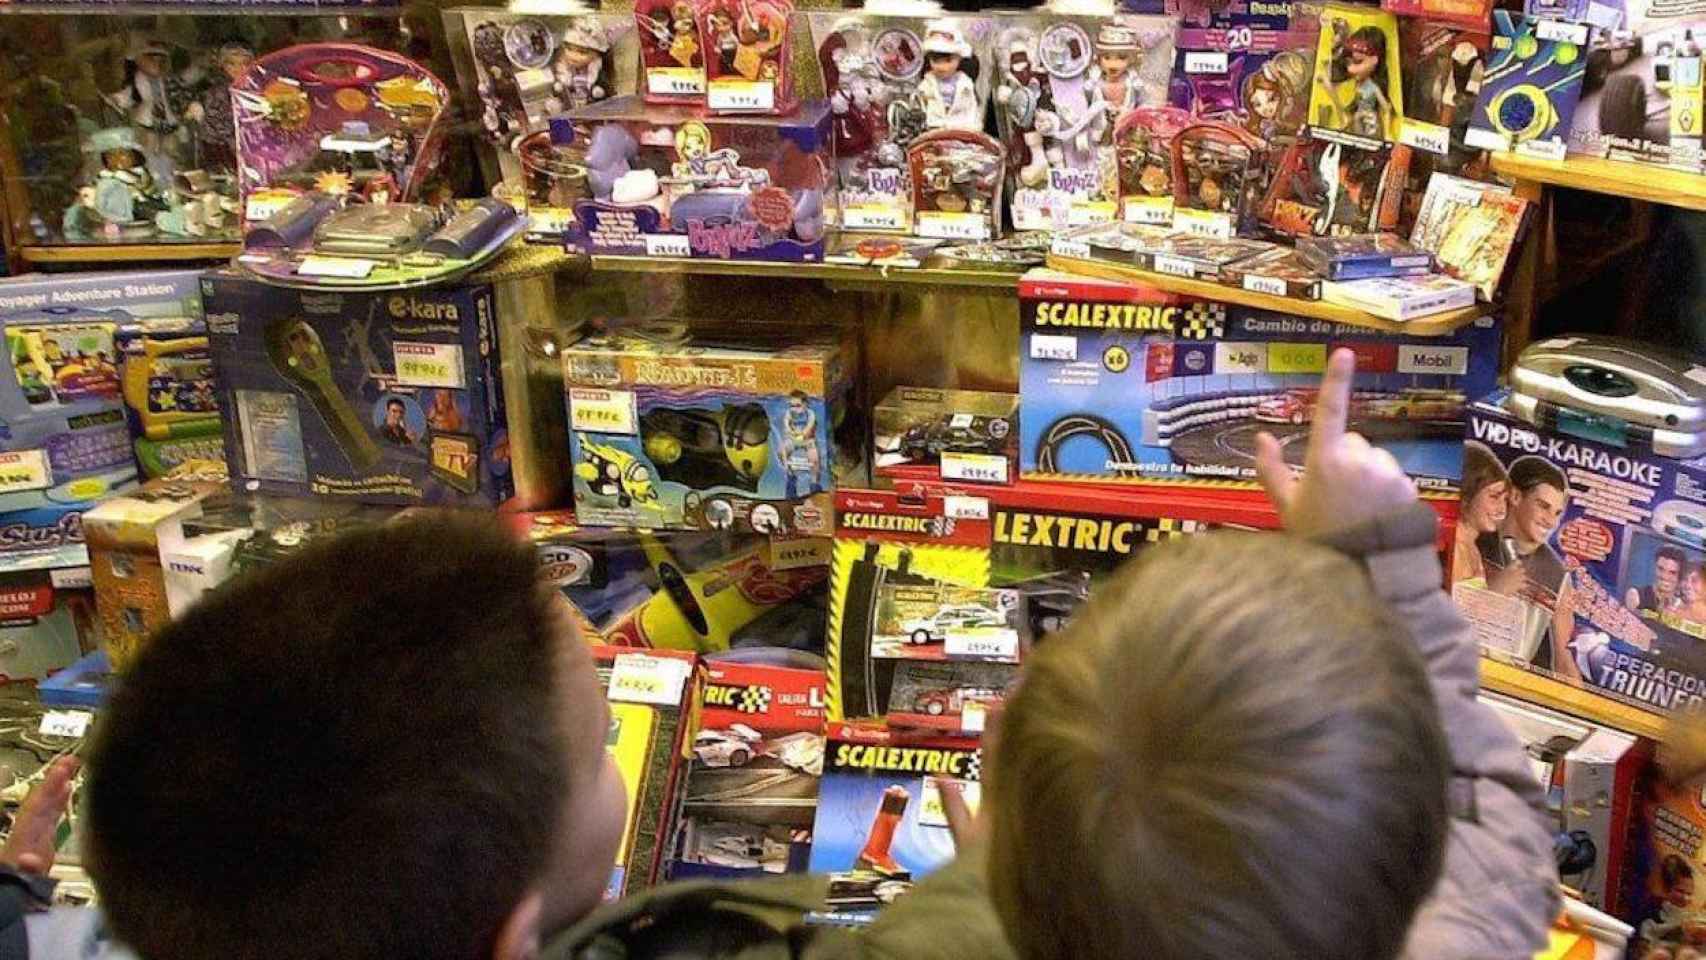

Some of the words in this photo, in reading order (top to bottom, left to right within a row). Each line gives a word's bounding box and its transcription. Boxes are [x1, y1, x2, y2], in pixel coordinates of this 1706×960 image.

[1227, 28, 1251, 48] 20
[52, 285, 122, 303] Adventure
[124, 282, 175, 299] Station
[1035, 301, 1177, 331] SCALEXTRIC
[1244, 317, 1306, 333] Cambio
[1310, 320, 1331, 333] de
[1413, 353, 1452, 367] Mobil
[1186, 463, 1239, 476] habilidad
[843, 511, 928, 533] SCALEXTRIC
[994, 510, 1135, 555] LEXTRIC
[703, 685, 739, 705] RIC
[834, 743, 966, 775] SCALEXTRIC
